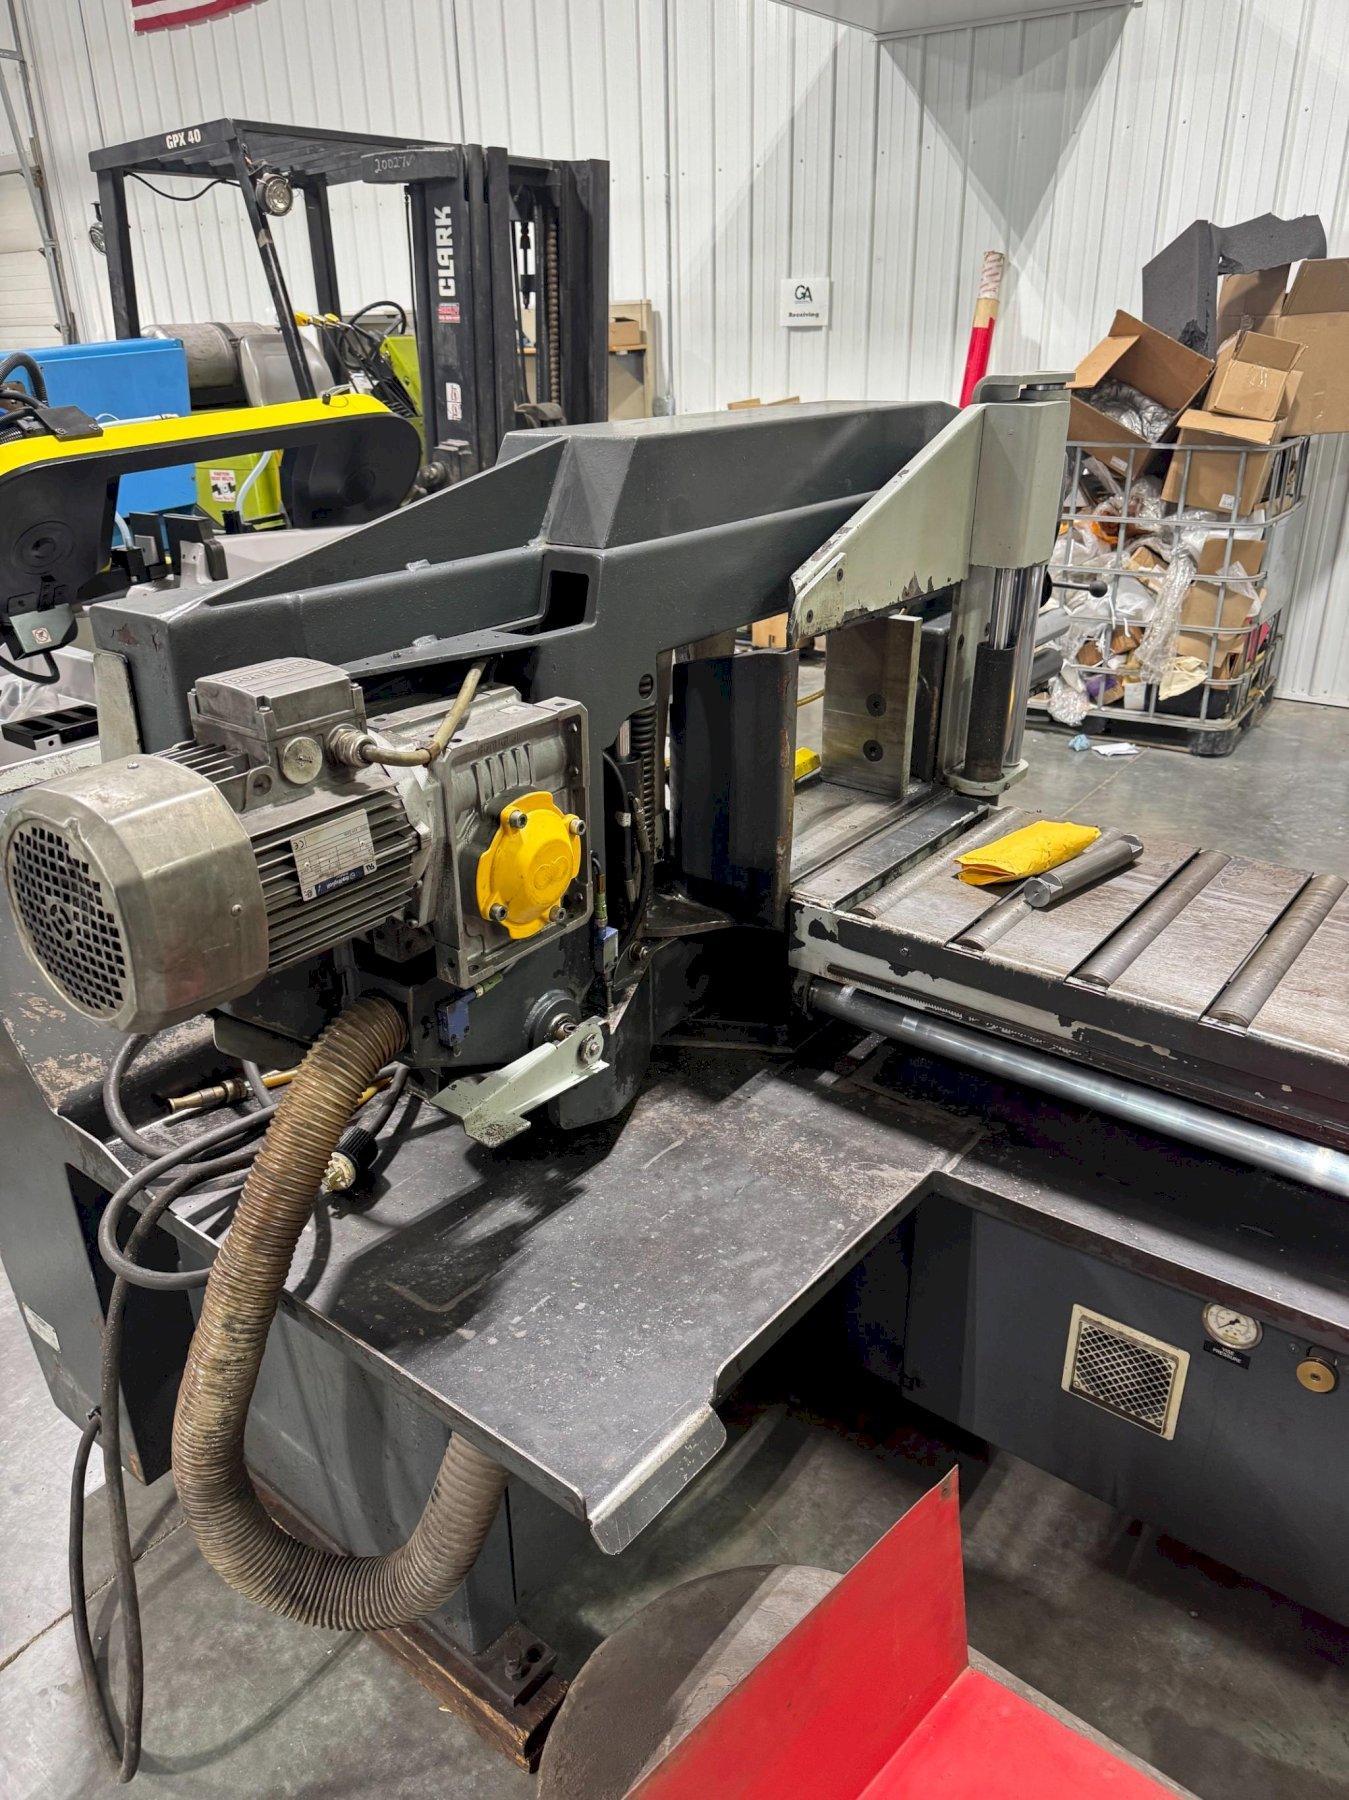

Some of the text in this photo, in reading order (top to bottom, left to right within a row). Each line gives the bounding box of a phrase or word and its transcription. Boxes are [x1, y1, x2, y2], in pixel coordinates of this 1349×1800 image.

[165, 128, 202, 150] GPX 40
[433, 205, 456, 297] CLARK
[1212, 1347, 1243, 1364] PRESSURE
